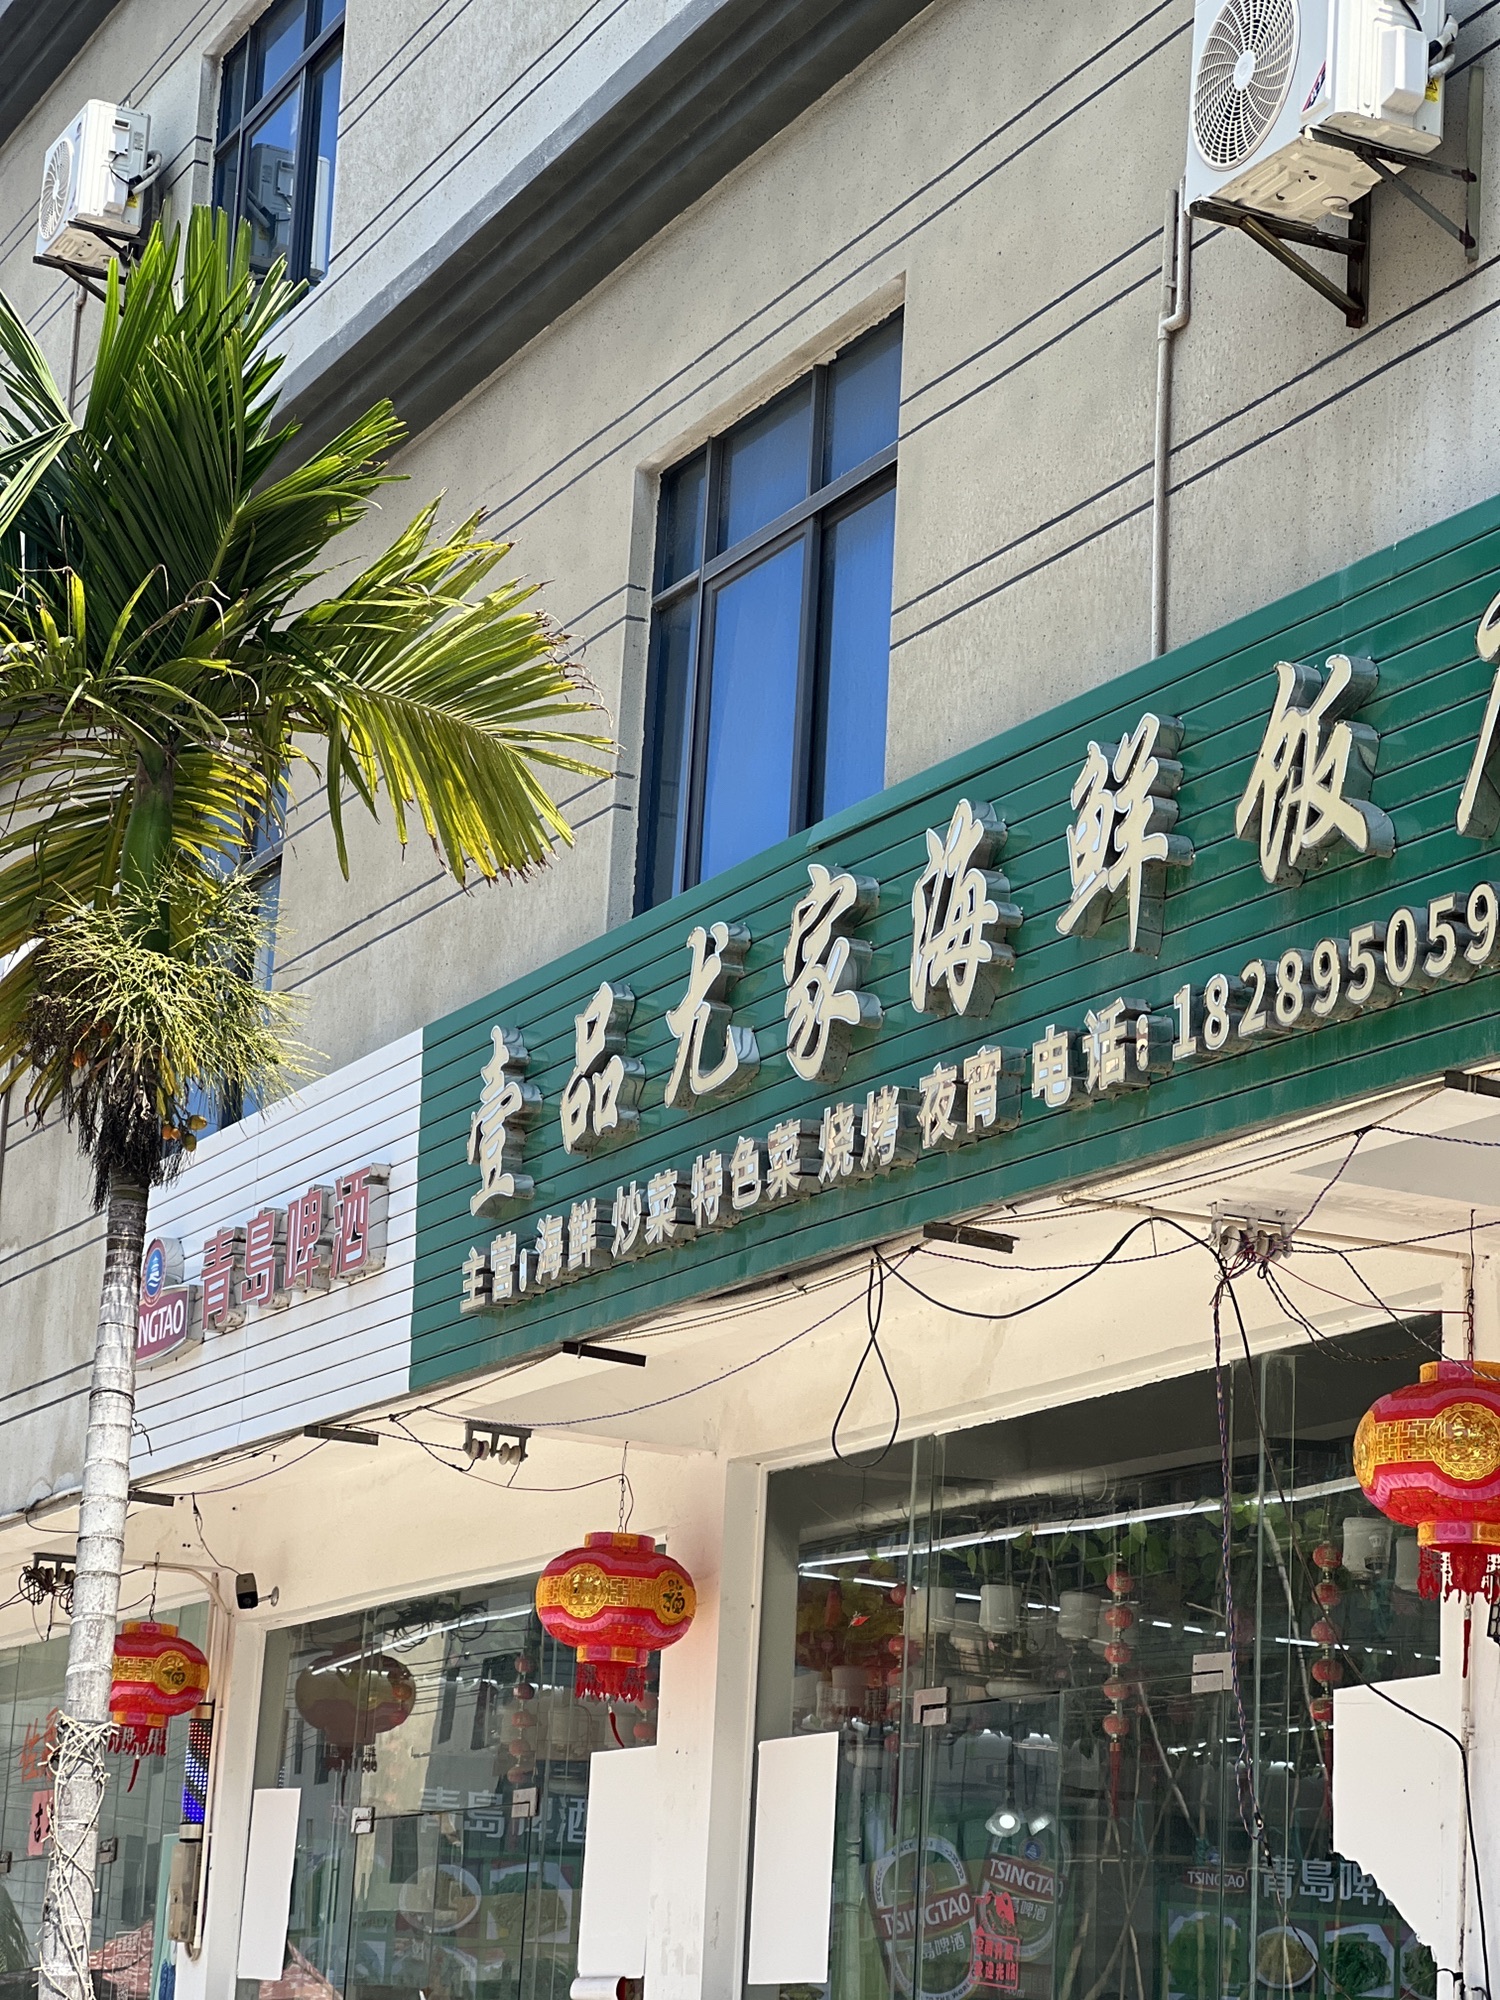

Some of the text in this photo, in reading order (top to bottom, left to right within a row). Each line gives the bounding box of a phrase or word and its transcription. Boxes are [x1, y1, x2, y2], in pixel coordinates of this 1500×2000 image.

[467, 590, 1500, 1217] 壹品尤家海鲜饭
[611, 1168, 678, 1259] 炒菜
[691, 1119, 801, 1228] 特色菜
[818, 1085, 899, 1184] 烧烤
[916, 1045, 1001, 1149] 夜宵
[137, 1299, 184, 1349] NGTAO
[1260, 1855, 1393, 1906] 青島啤
